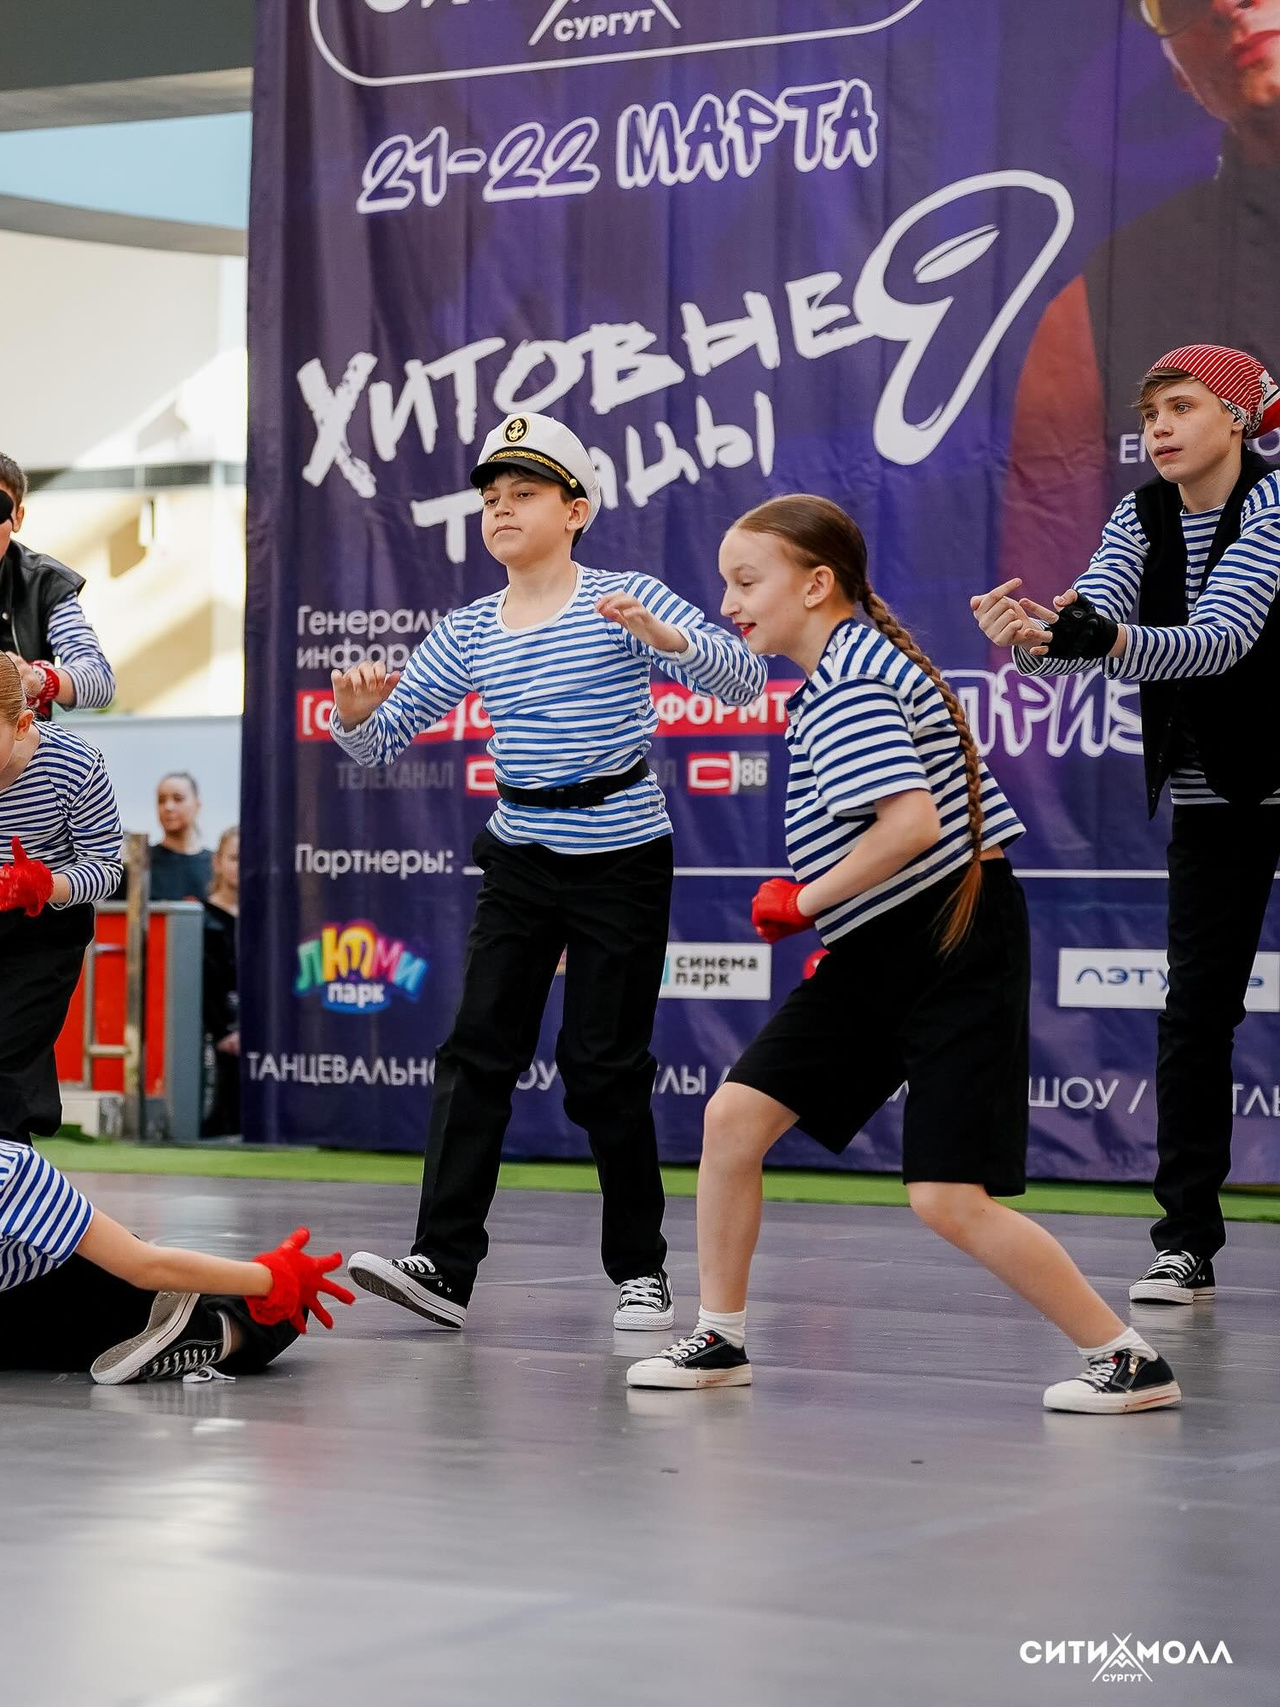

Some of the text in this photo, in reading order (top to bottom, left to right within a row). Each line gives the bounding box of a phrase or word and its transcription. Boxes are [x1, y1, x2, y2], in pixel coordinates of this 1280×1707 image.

[553, 9, 656, 43] СУРГУТ
[356, 79, 878, 214] 21-22 МАРТА
[296, 637, 414, 674] инфор
[295, 843, 454, 880] Партнеры:
[675, 956, 759, 971] синема
[327, 982, 386, 1009] парк
[675, 972, 731, 991] парк
